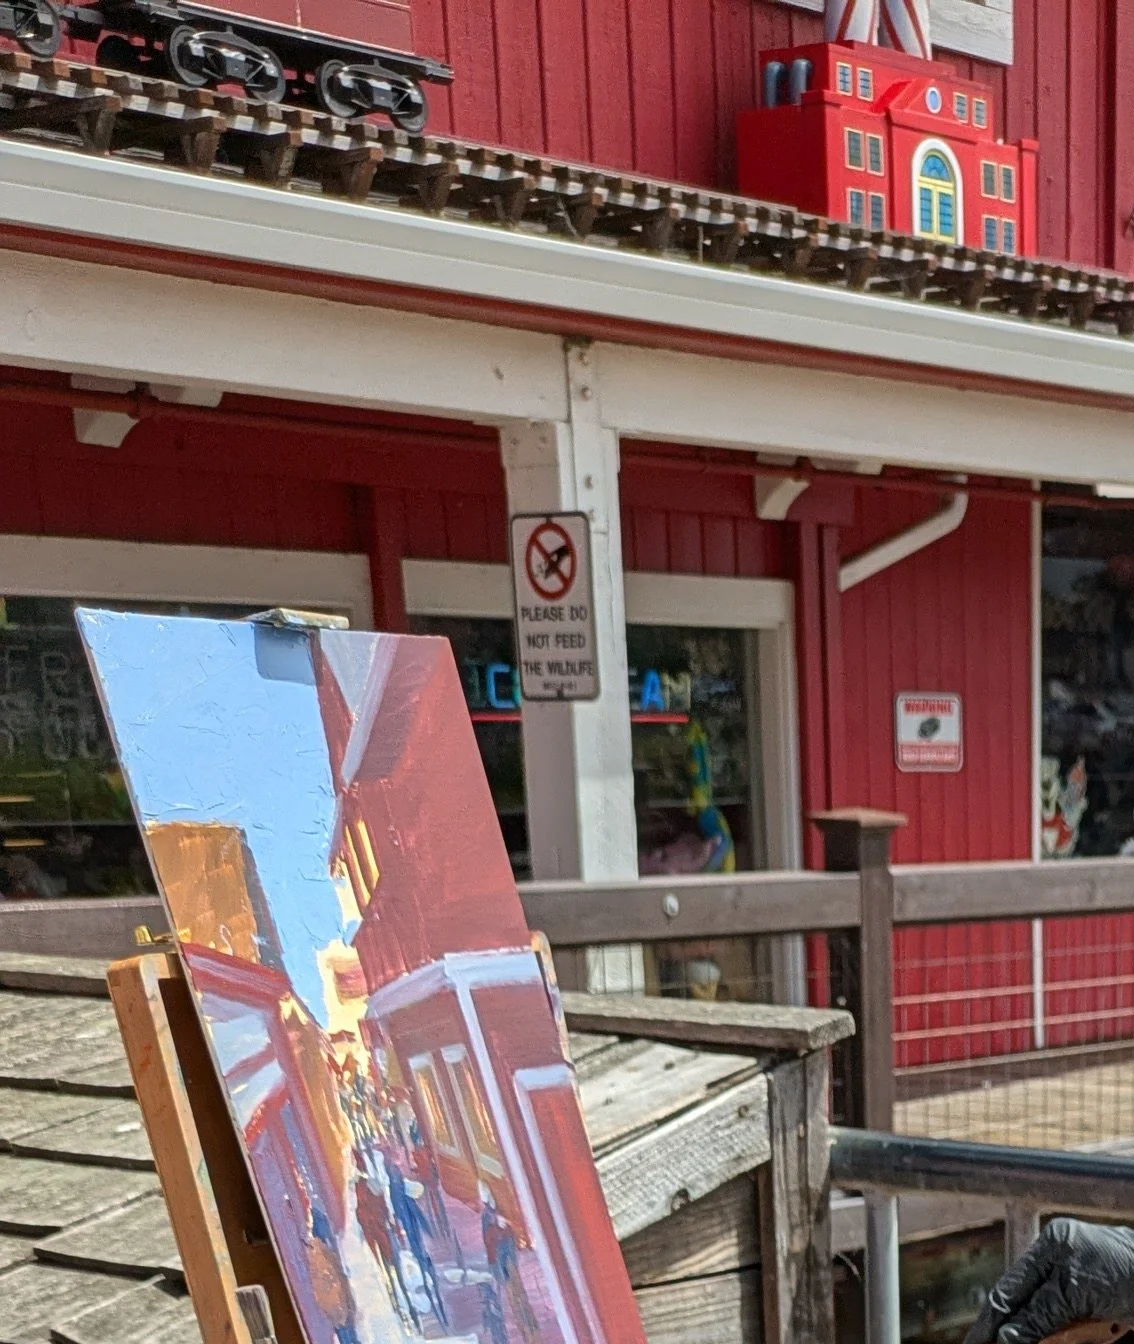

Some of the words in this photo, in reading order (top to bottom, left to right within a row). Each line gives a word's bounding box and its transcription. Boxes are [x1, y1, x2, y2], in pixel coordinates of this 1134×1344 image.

[521, 606, 565, 622] PLEASE
[569, 606, 588, 622] DO
[526, 633, 550, 649] NOT
[555, 633, 587, 649] FEED
[523, 661, 543, 676] THE
[547, 661, 594, 677] WILDLIFE
[465, 659, 522, 710] IC
